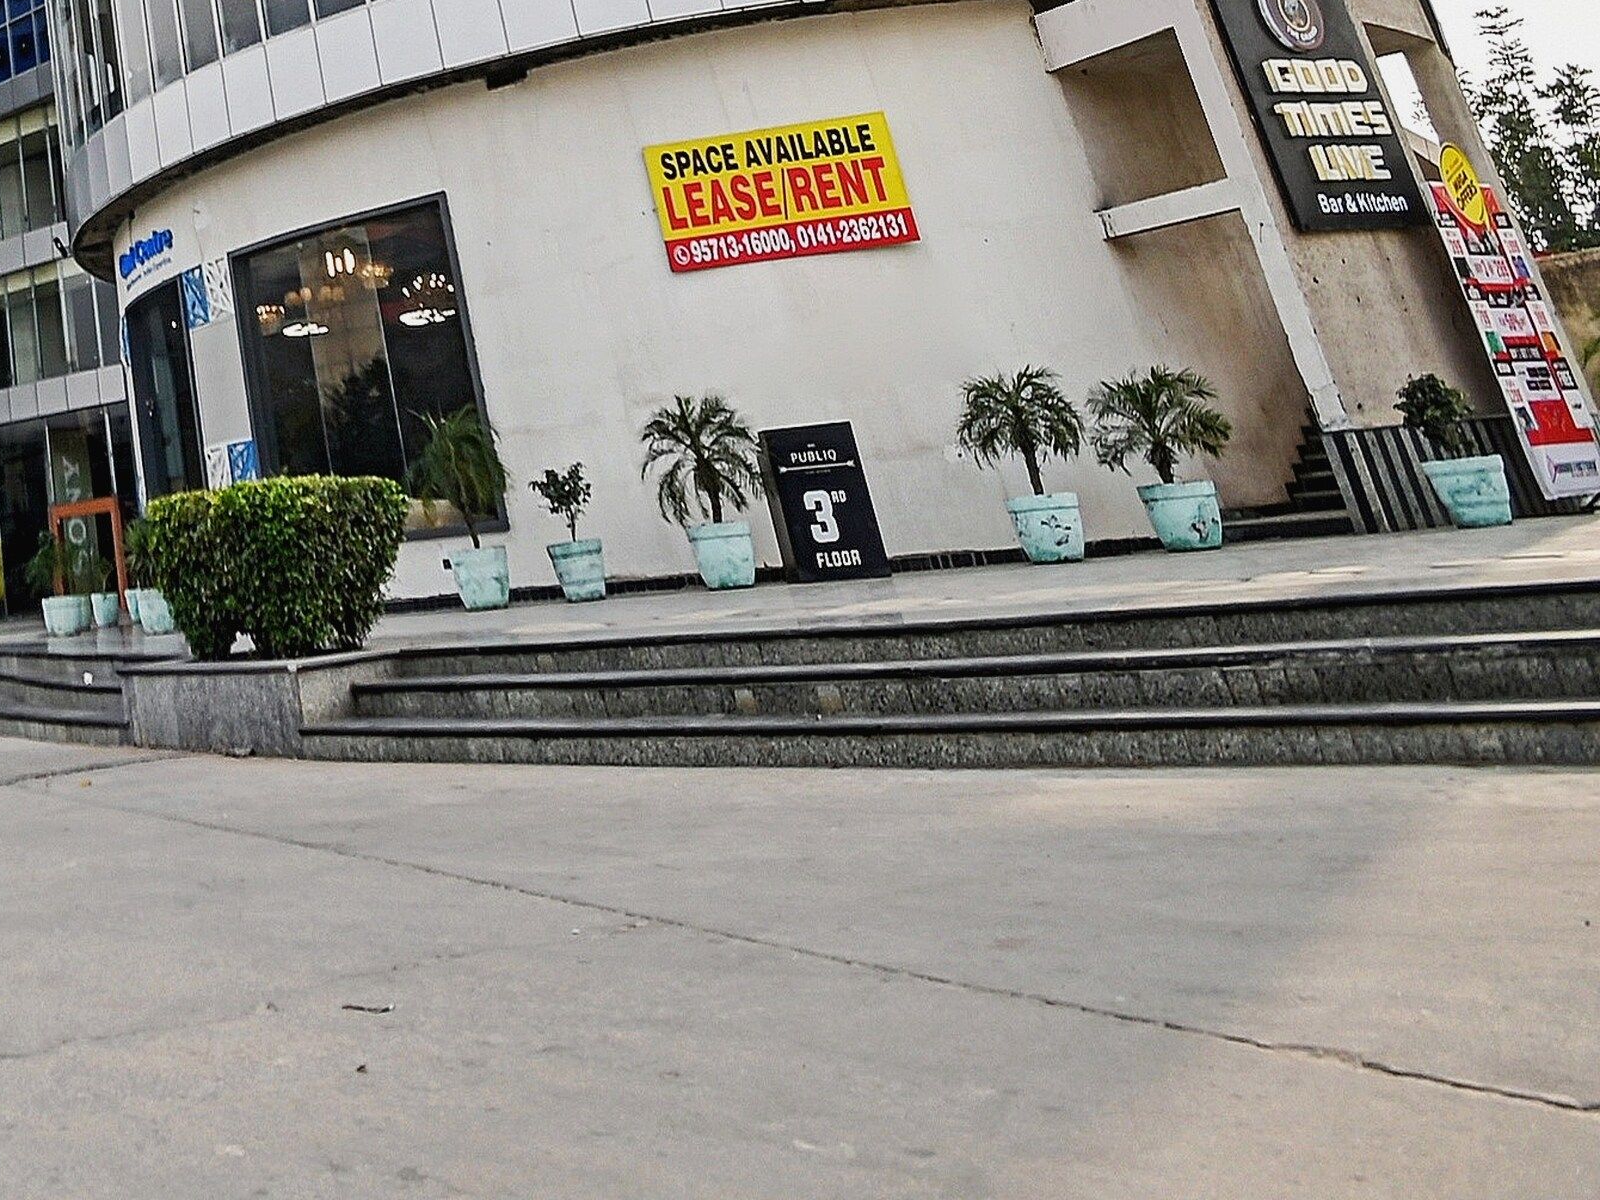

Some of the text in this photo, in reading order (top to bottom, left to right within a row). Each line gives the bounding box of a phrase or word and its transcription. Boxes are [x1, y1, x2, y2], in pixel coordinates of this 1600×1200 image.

[1262, 58, 1368, 93] GOOD
[1273, 100, 1392, 137] TIMES
[660, 123, 876, 180] SPACE AVAILABLE
[1308, 144, 1392, 181] LIVE
[662, 156, 888, 231] LEASE/RENT
[1317, 192, 1409, 214] Bar & Kitchen
[691, 214, 909, 264] 95713-16000, 0141-2362131
[816, 549, 862, 569] FLOOR
